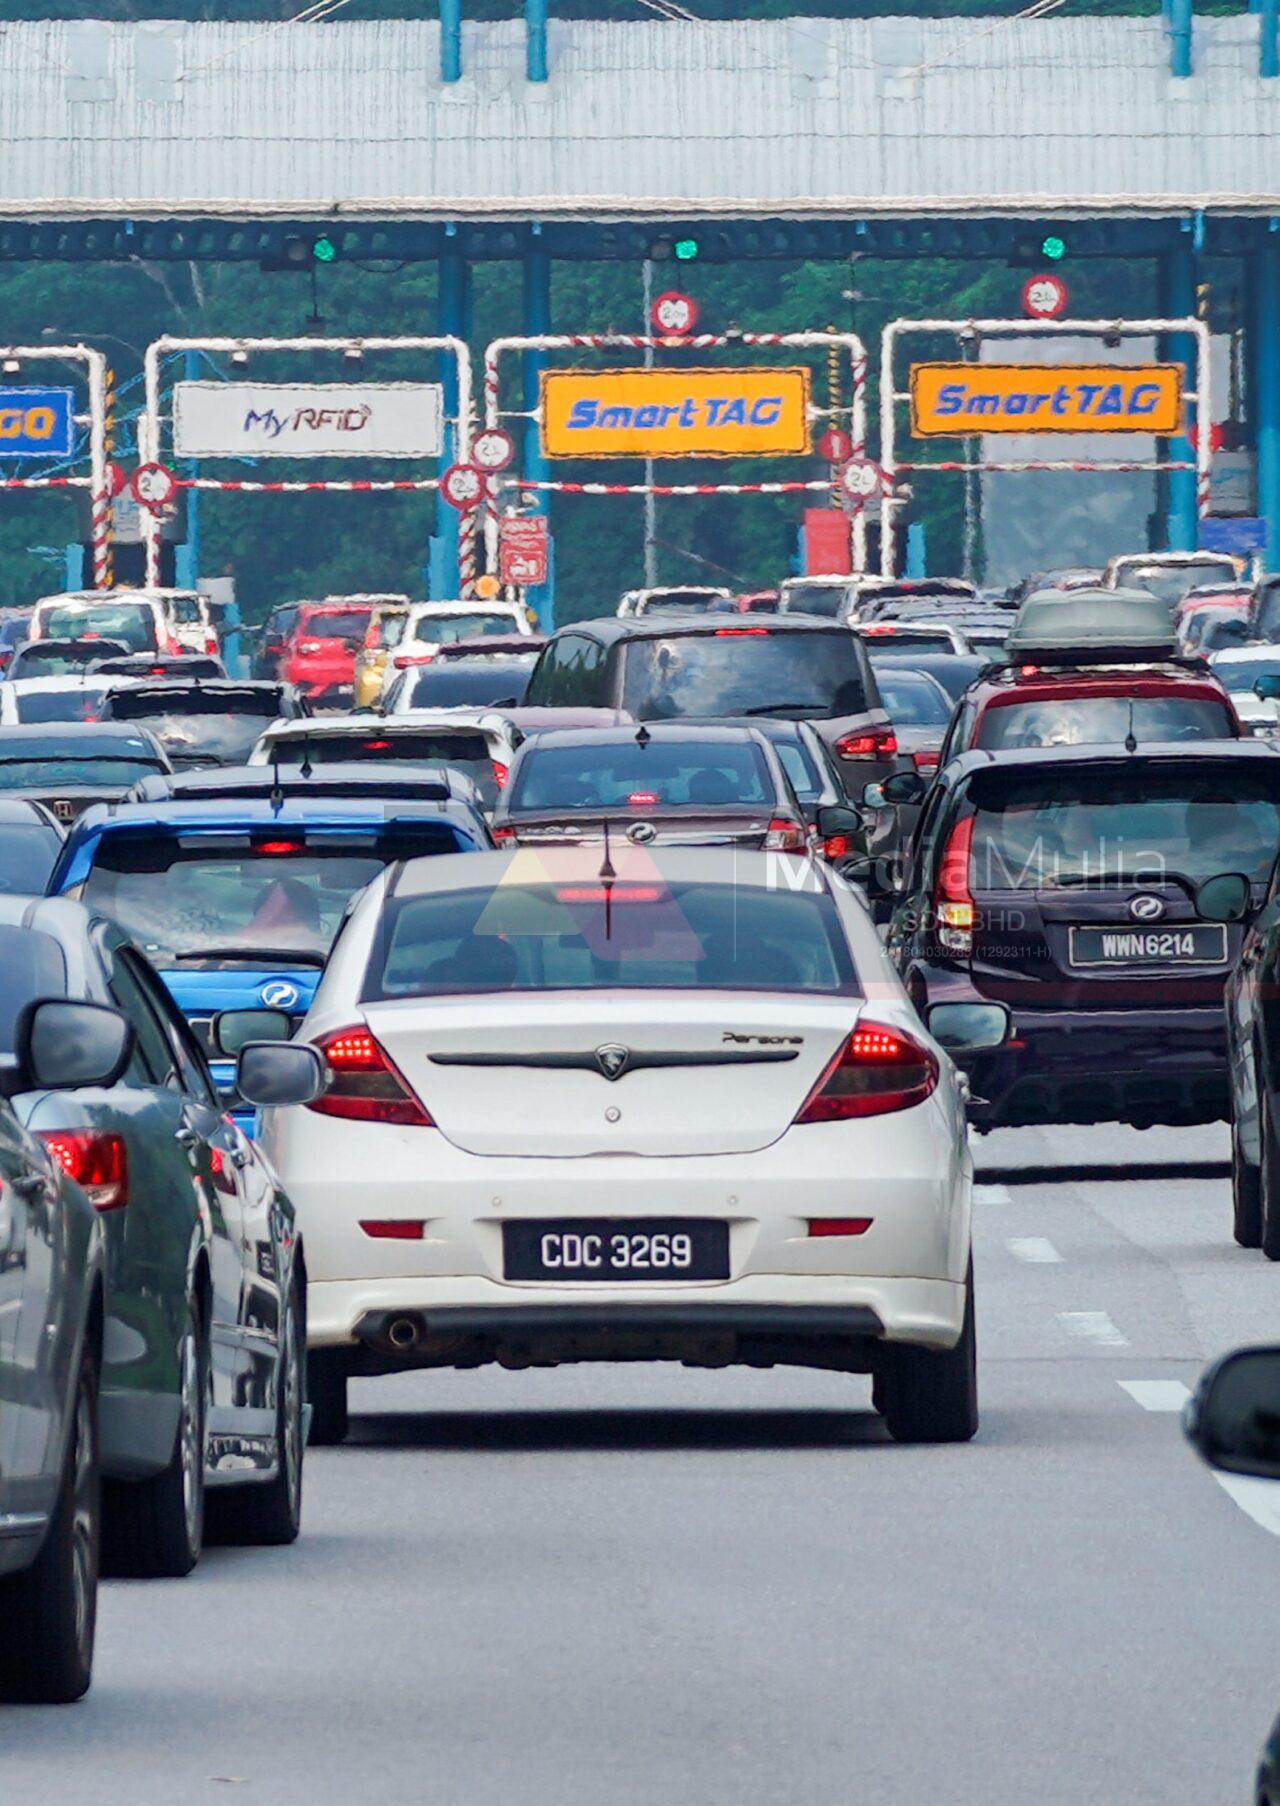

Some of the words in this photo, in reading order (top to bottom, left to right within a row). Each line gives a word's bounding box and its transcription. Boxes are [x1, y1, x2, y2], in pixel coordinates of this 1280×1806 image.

[1101, 932, 1195, 957] WWN6214
[541, 1233, 603, 1269] CDC
[610, 1233, 694, 1269] 3269
